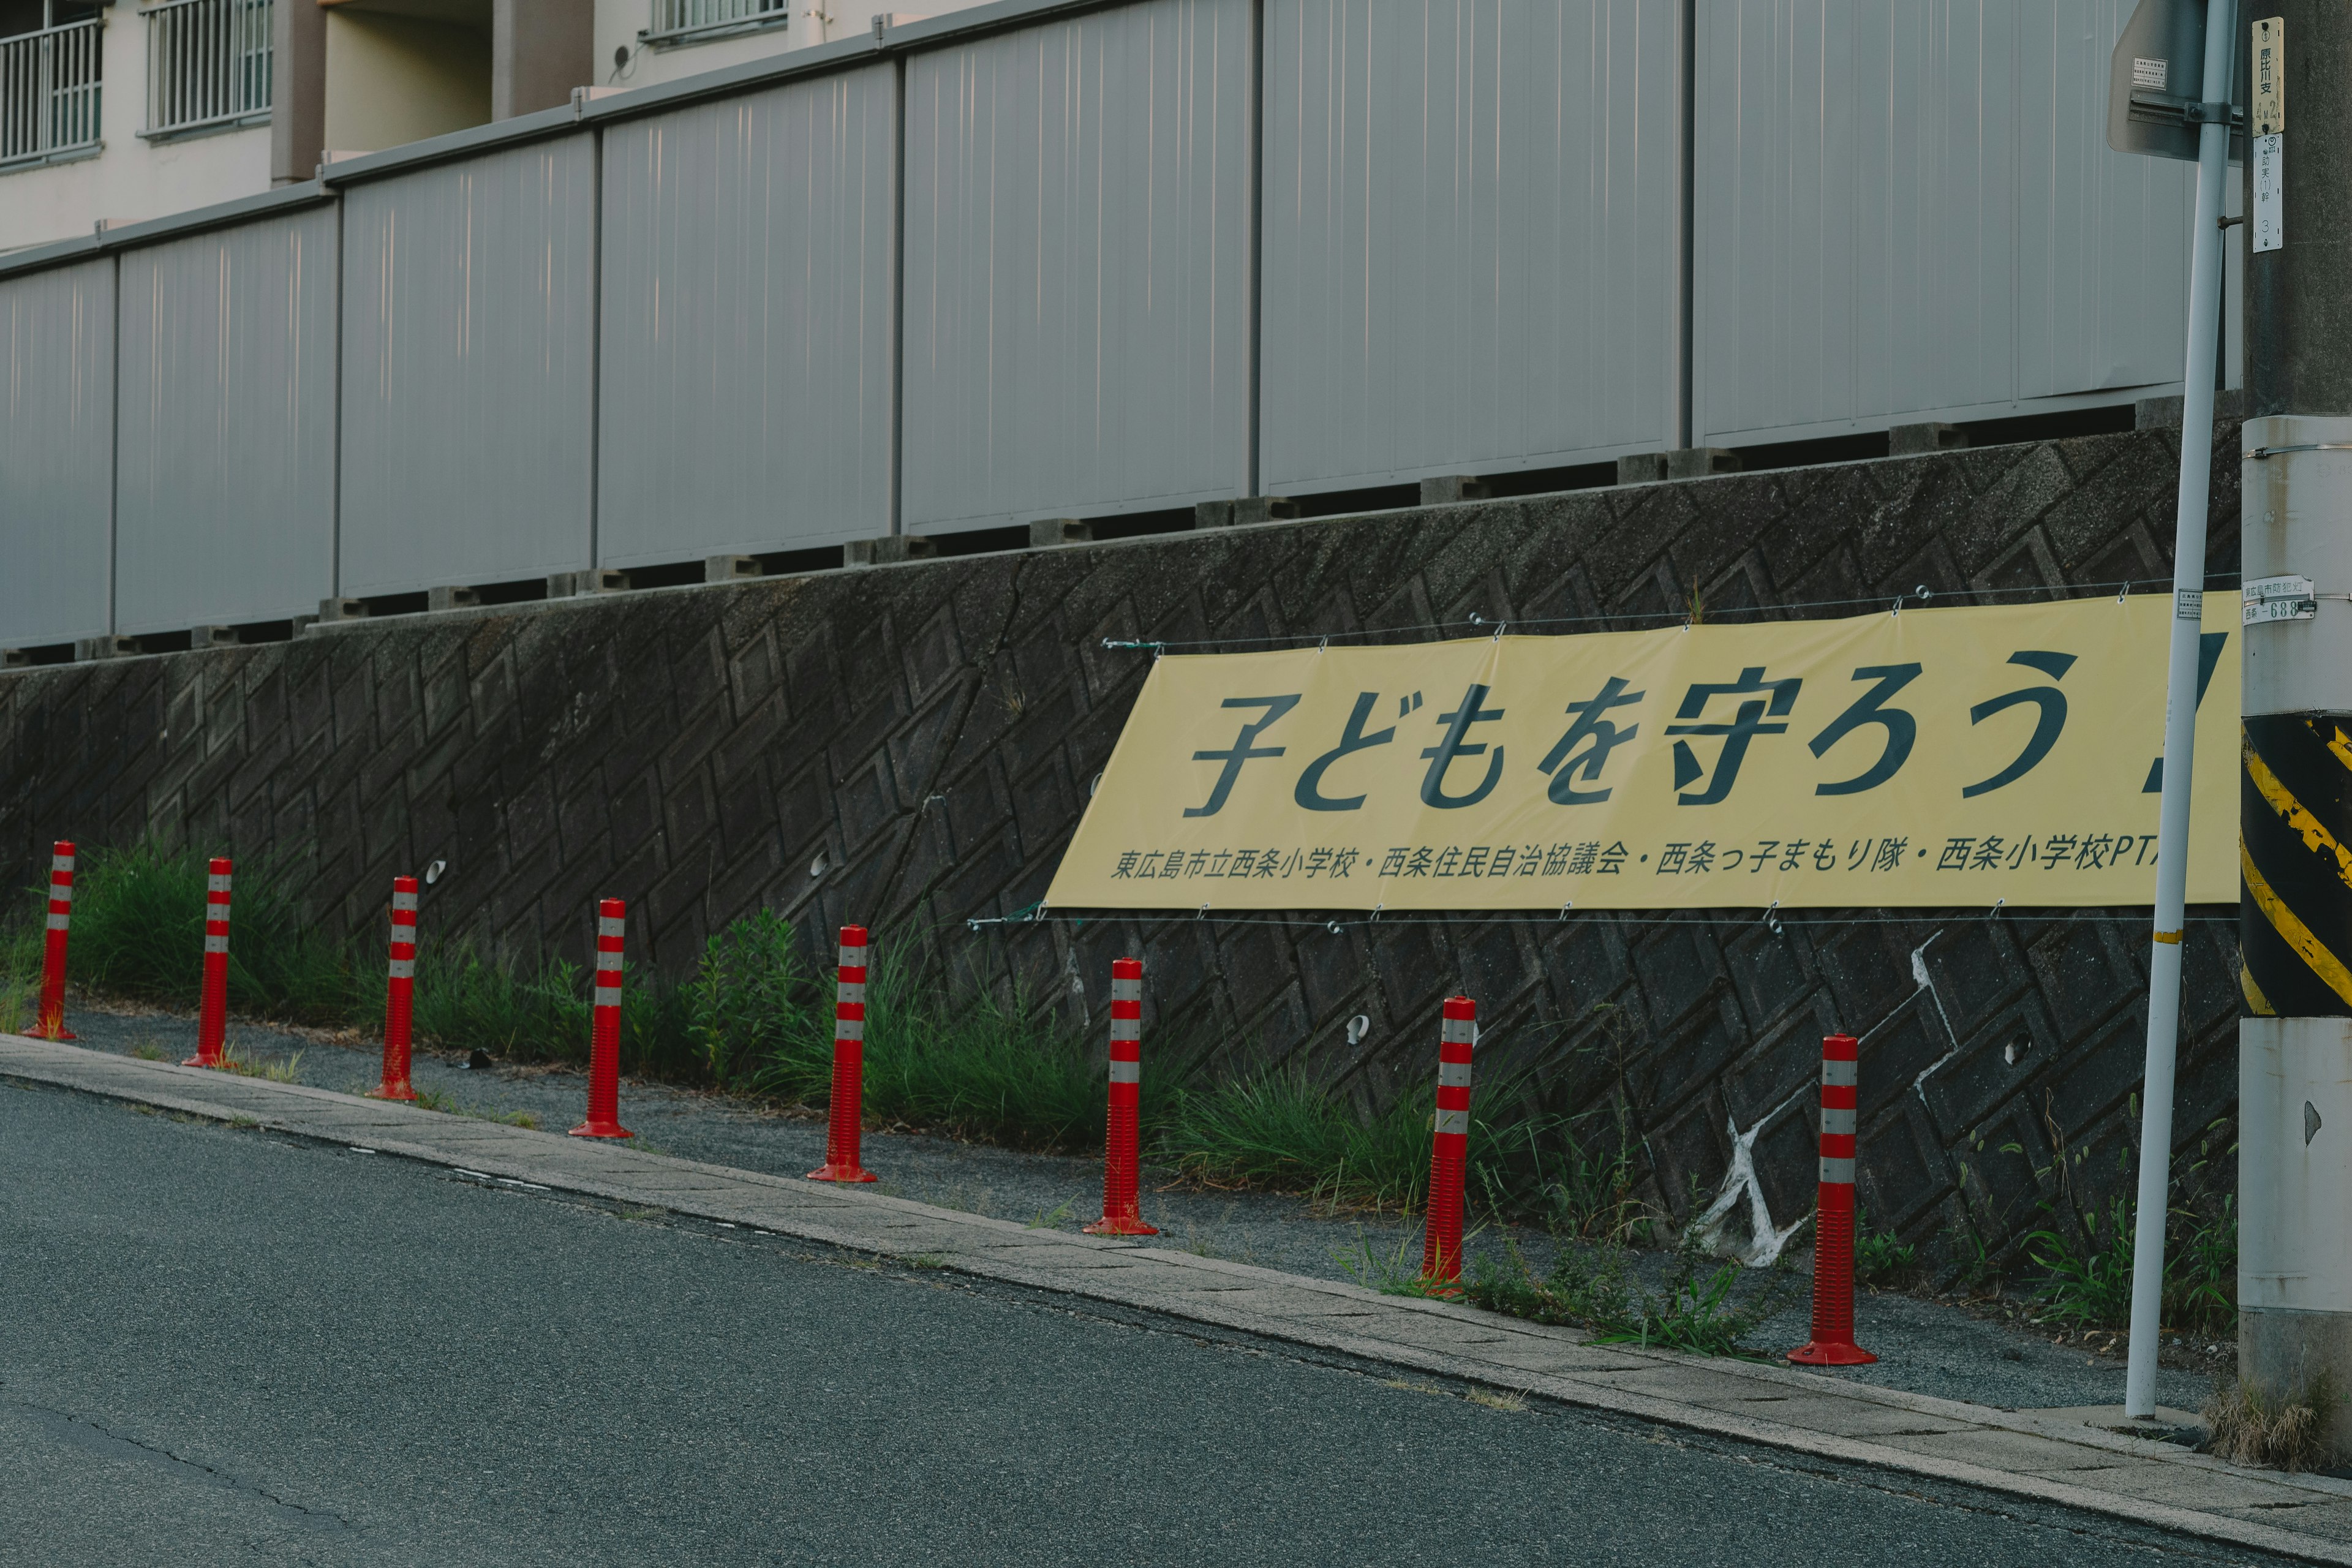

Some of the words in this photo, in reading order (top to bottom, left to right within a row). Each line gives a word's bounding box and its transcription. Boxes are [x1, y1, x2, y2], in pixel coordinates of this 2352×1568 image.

[2260, 48, 2271, 95] 原比川支
[2260, 156, 2271, 203] 助実(1)幹
[2262, 219, 2269, 233] 3
[2245, 581, 2303, 598] 東広島市防犯灯
